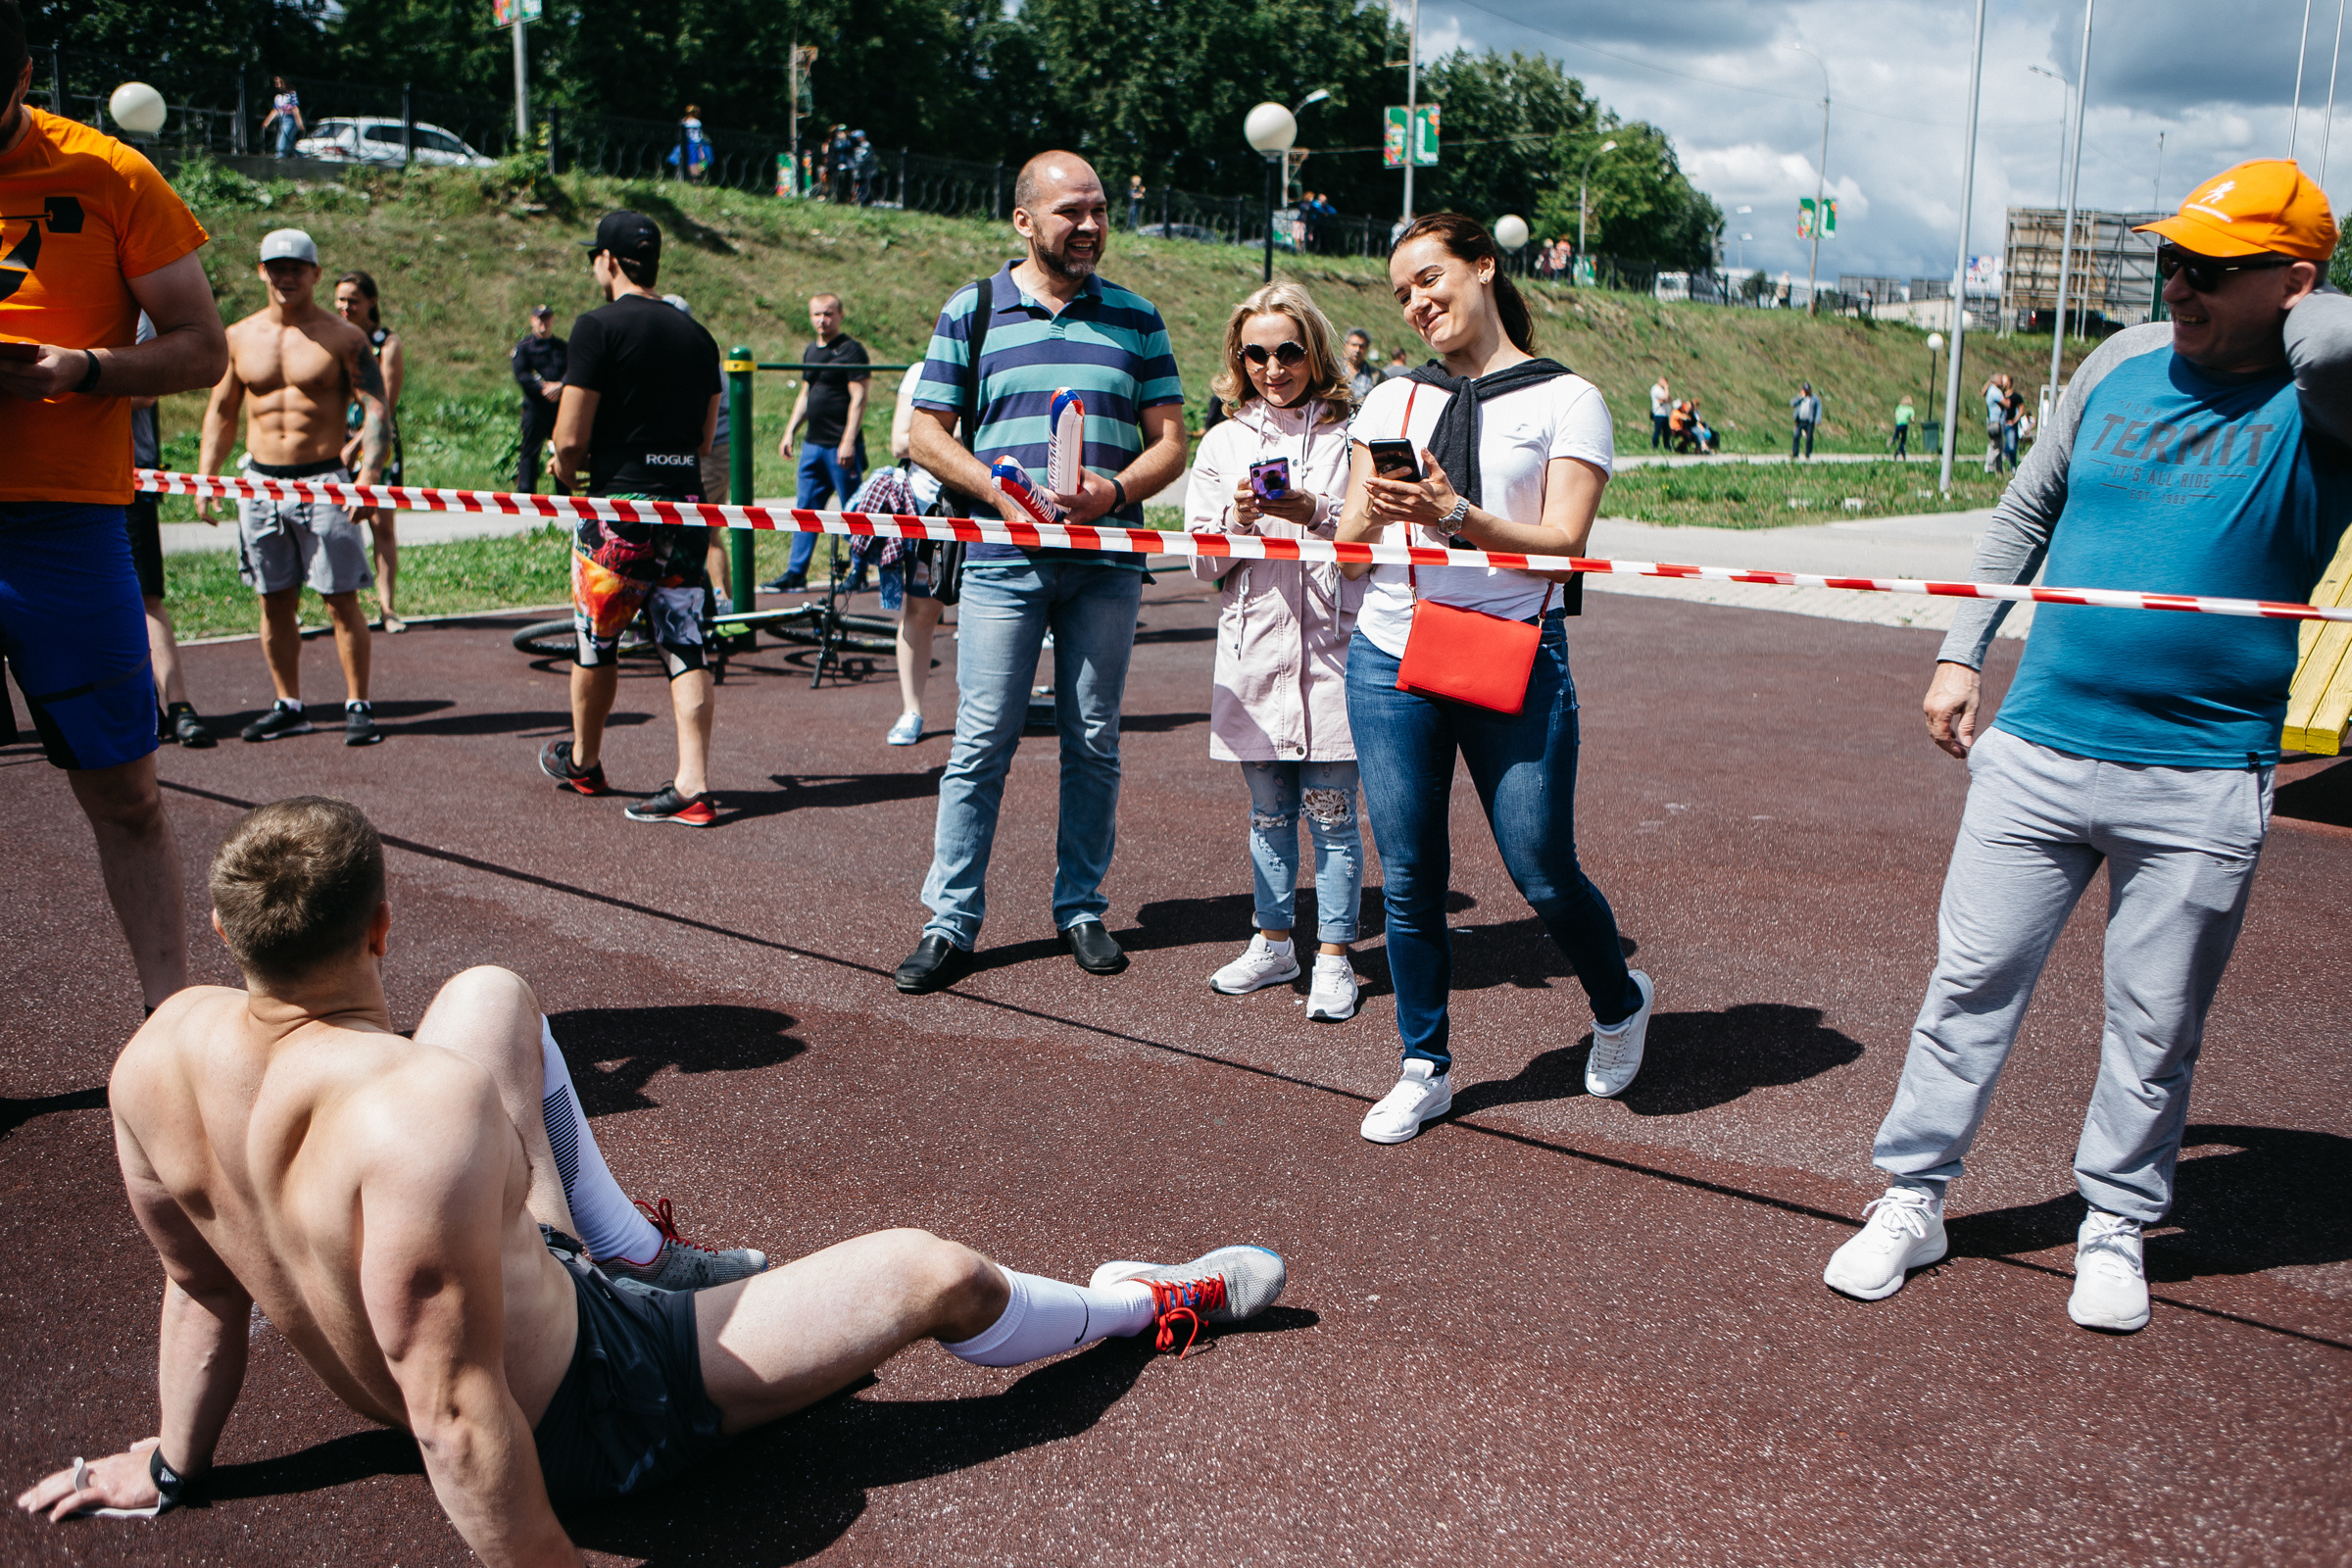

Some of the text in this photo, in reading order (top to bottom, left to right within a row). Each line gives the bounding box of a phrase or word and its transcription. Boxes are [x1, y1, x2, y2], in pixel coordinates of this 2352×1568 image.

[2090, 414, 2274, 467] TERMIT
[646, 454, 695, 466] ROGUE
[2112, 465, 2213, 489] IT'S ALL RIDE
[2130, 489, 2187, 505] EST. 1989
